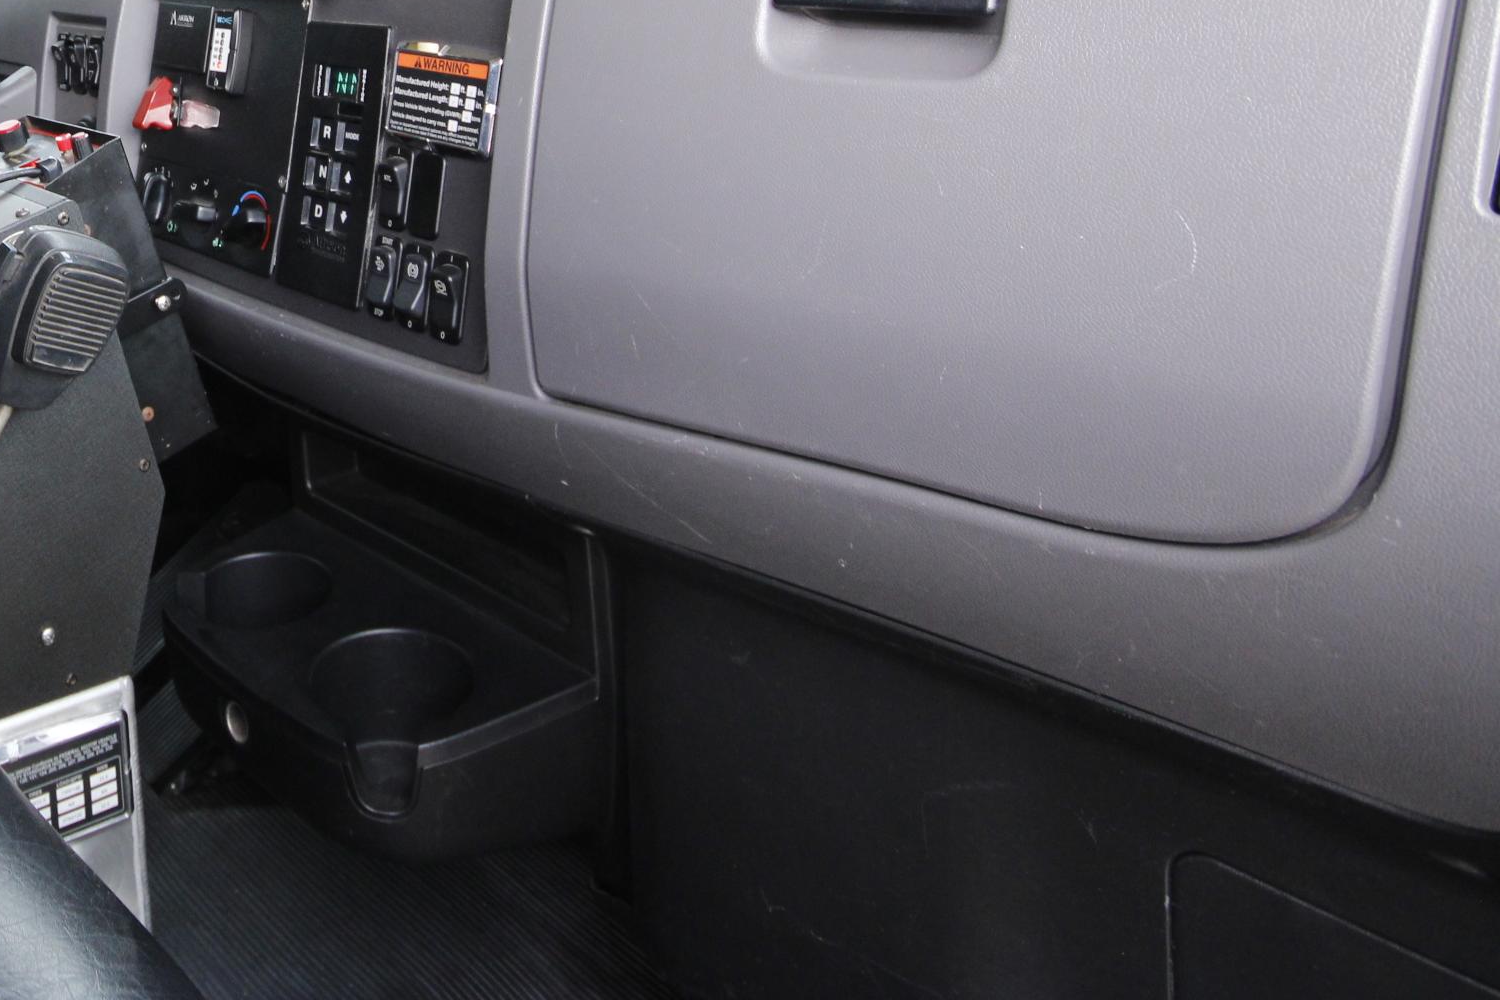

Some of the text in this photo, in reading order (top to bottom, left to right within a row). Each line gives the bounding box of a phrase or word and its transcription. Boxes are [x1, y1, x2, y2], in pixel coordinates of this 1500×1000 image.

[423, 57, 469, 75] WARNING
[396, 74, 430, 88] Manufactured
[394, 86, 429, 100] Manufactured
[323, 125, 332, 139] R
[345, 131, 360, 141] MODE
[319, 164, 328, 179] N
[314, 204, 323, 218] D
